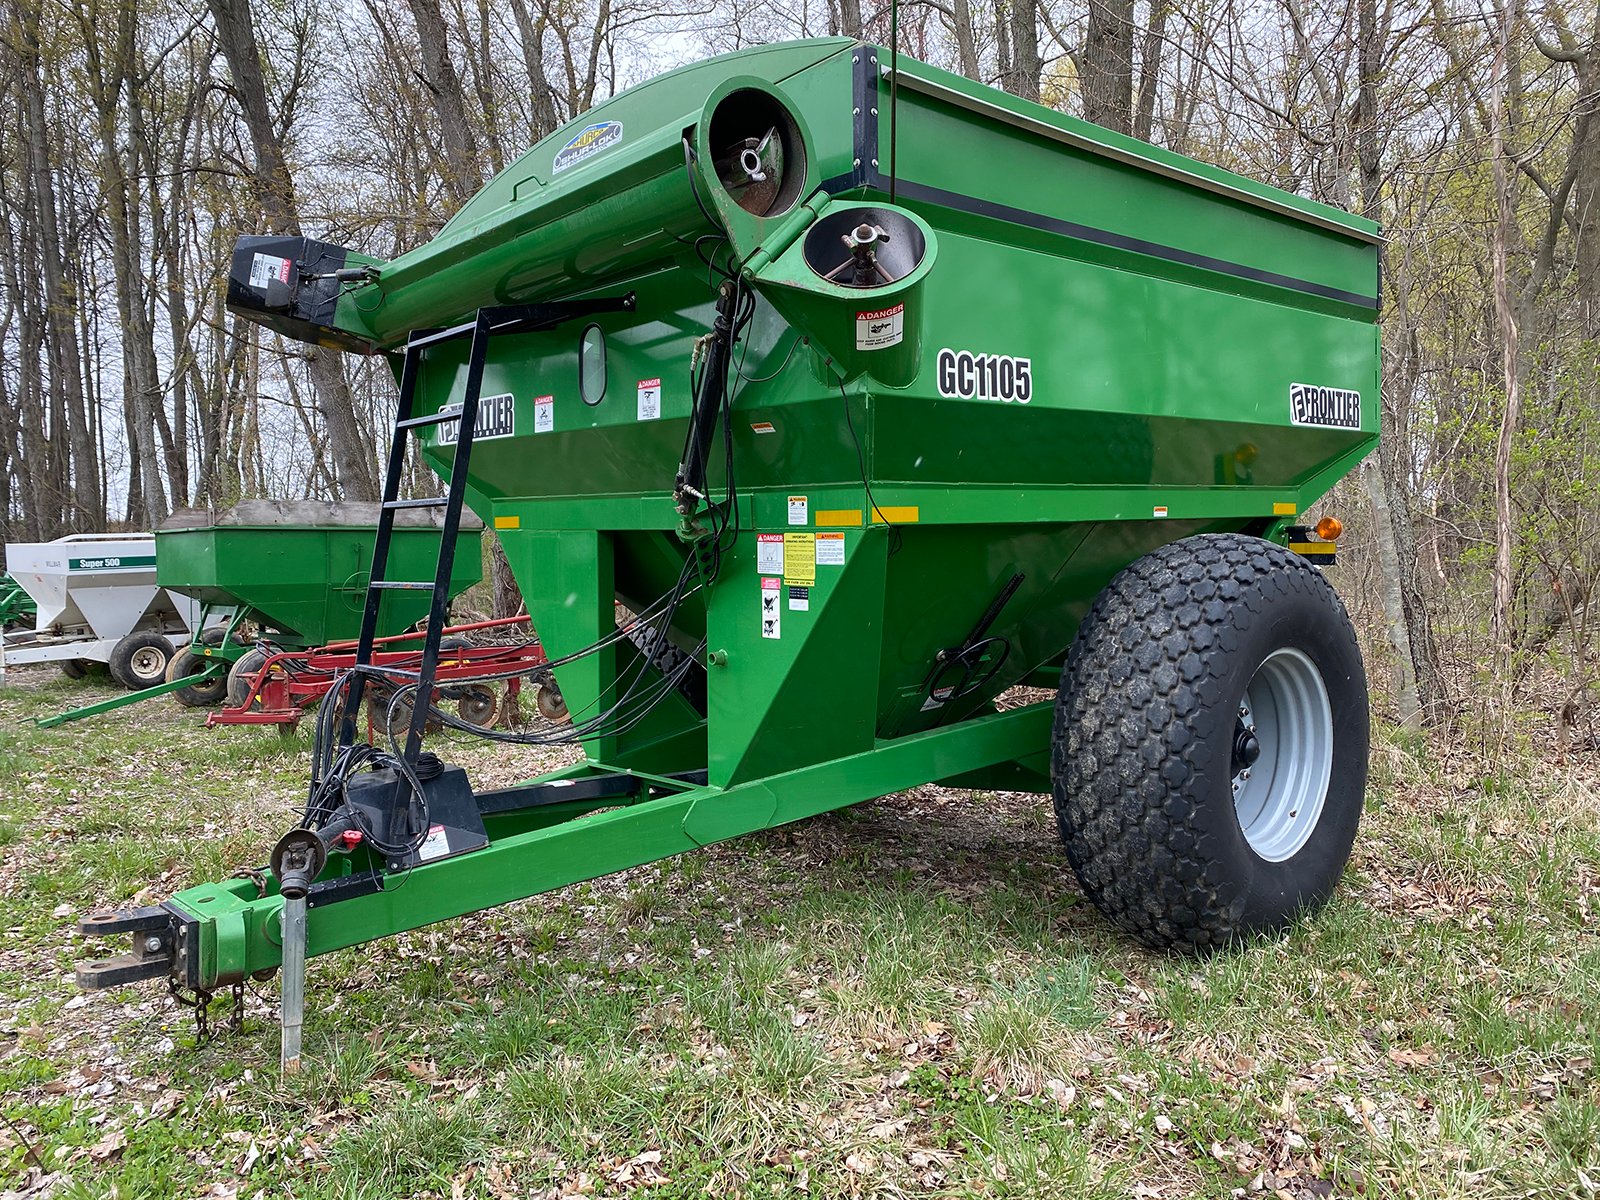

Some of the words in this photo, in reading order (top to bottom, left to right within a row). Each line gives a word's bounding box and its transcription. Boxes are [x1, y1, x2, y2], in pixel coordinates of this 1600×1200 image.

[561, 132, 613, 166] SHUR-LOK
[866, 303, 904, 320] DANGER
[642, 379, 660, 388] DANGER
[940, 351, 1030, 400] GC1105
[1304, 386, 1359, 421] FRONTIER
[80, 559, 103, 568] Super
[105, 558, 120, 567] 500
